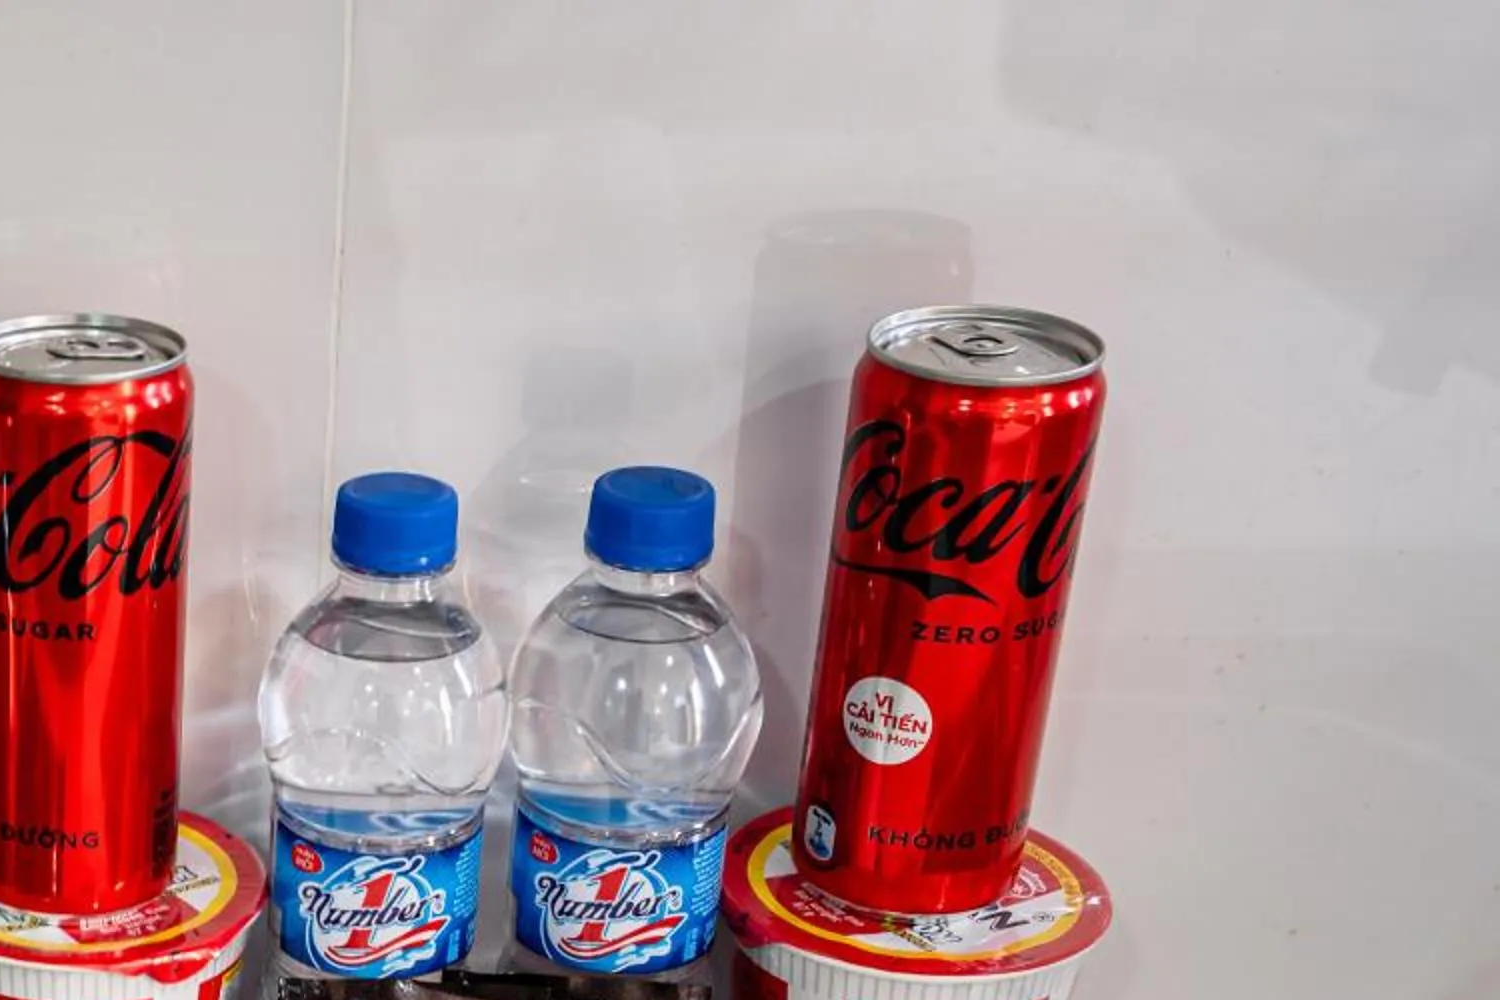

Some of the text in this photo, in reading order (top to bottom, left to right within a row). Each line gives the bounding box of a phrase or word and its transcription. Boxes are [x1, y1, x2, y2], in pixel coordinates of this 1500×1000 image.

[910, 610, 1059, 644] ZERO SUG
[302, 885, 441, 931] Number
[538, 876, 678, 921] Number
